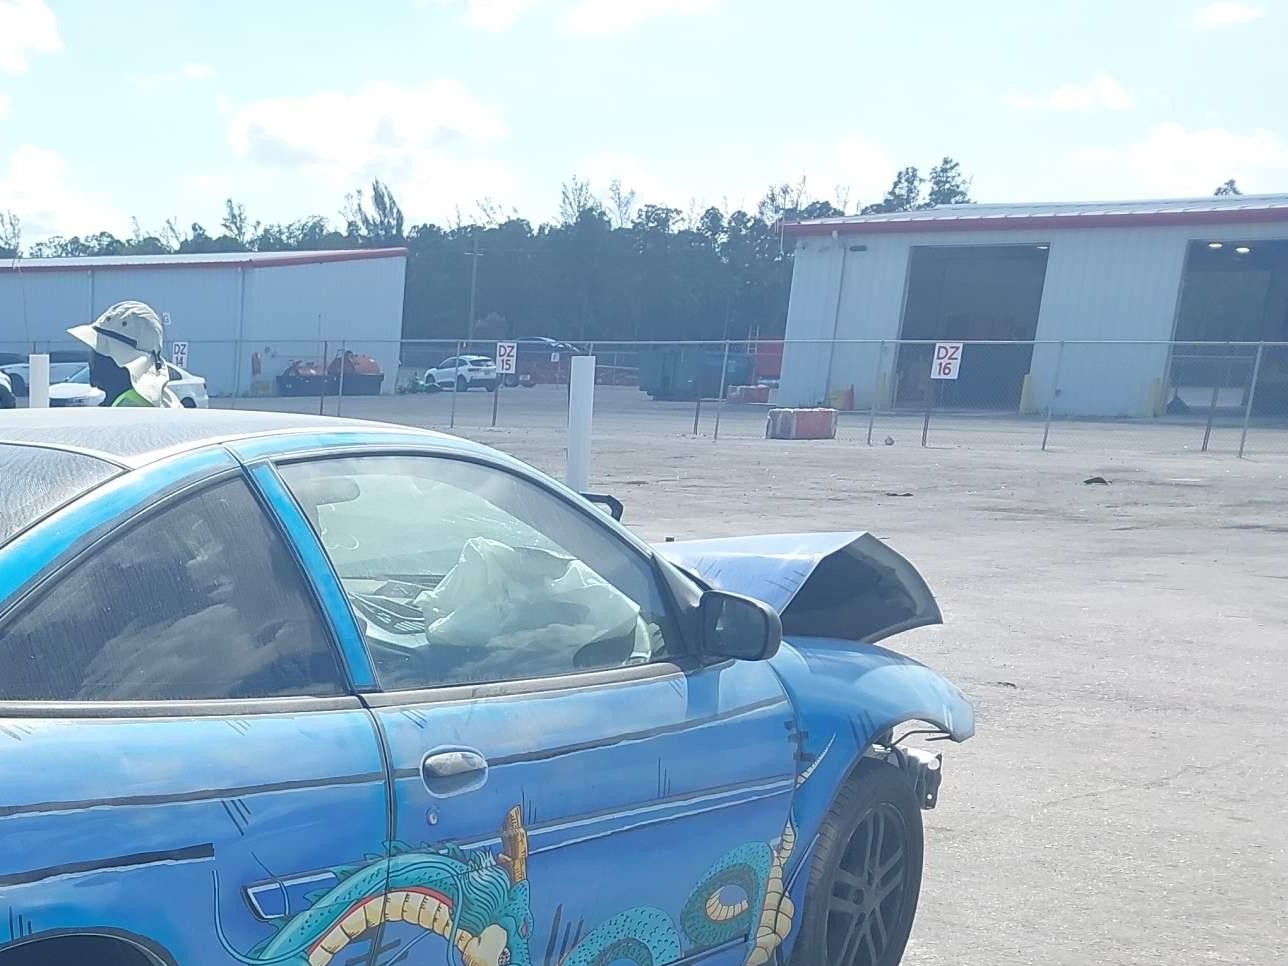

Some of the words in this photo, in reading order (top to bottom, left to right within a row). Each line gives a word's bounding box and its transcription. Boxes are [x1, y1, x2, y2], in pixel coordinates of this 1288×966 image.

[174, 343, 187, 355] DZ
[499, 344, 515, 358] DZ
[936, 345, 960, 361] DZ
[175, 356, 184, 367] 14
[501, 358, 511, 371] 15
[938, 362, 952, 376] 16
